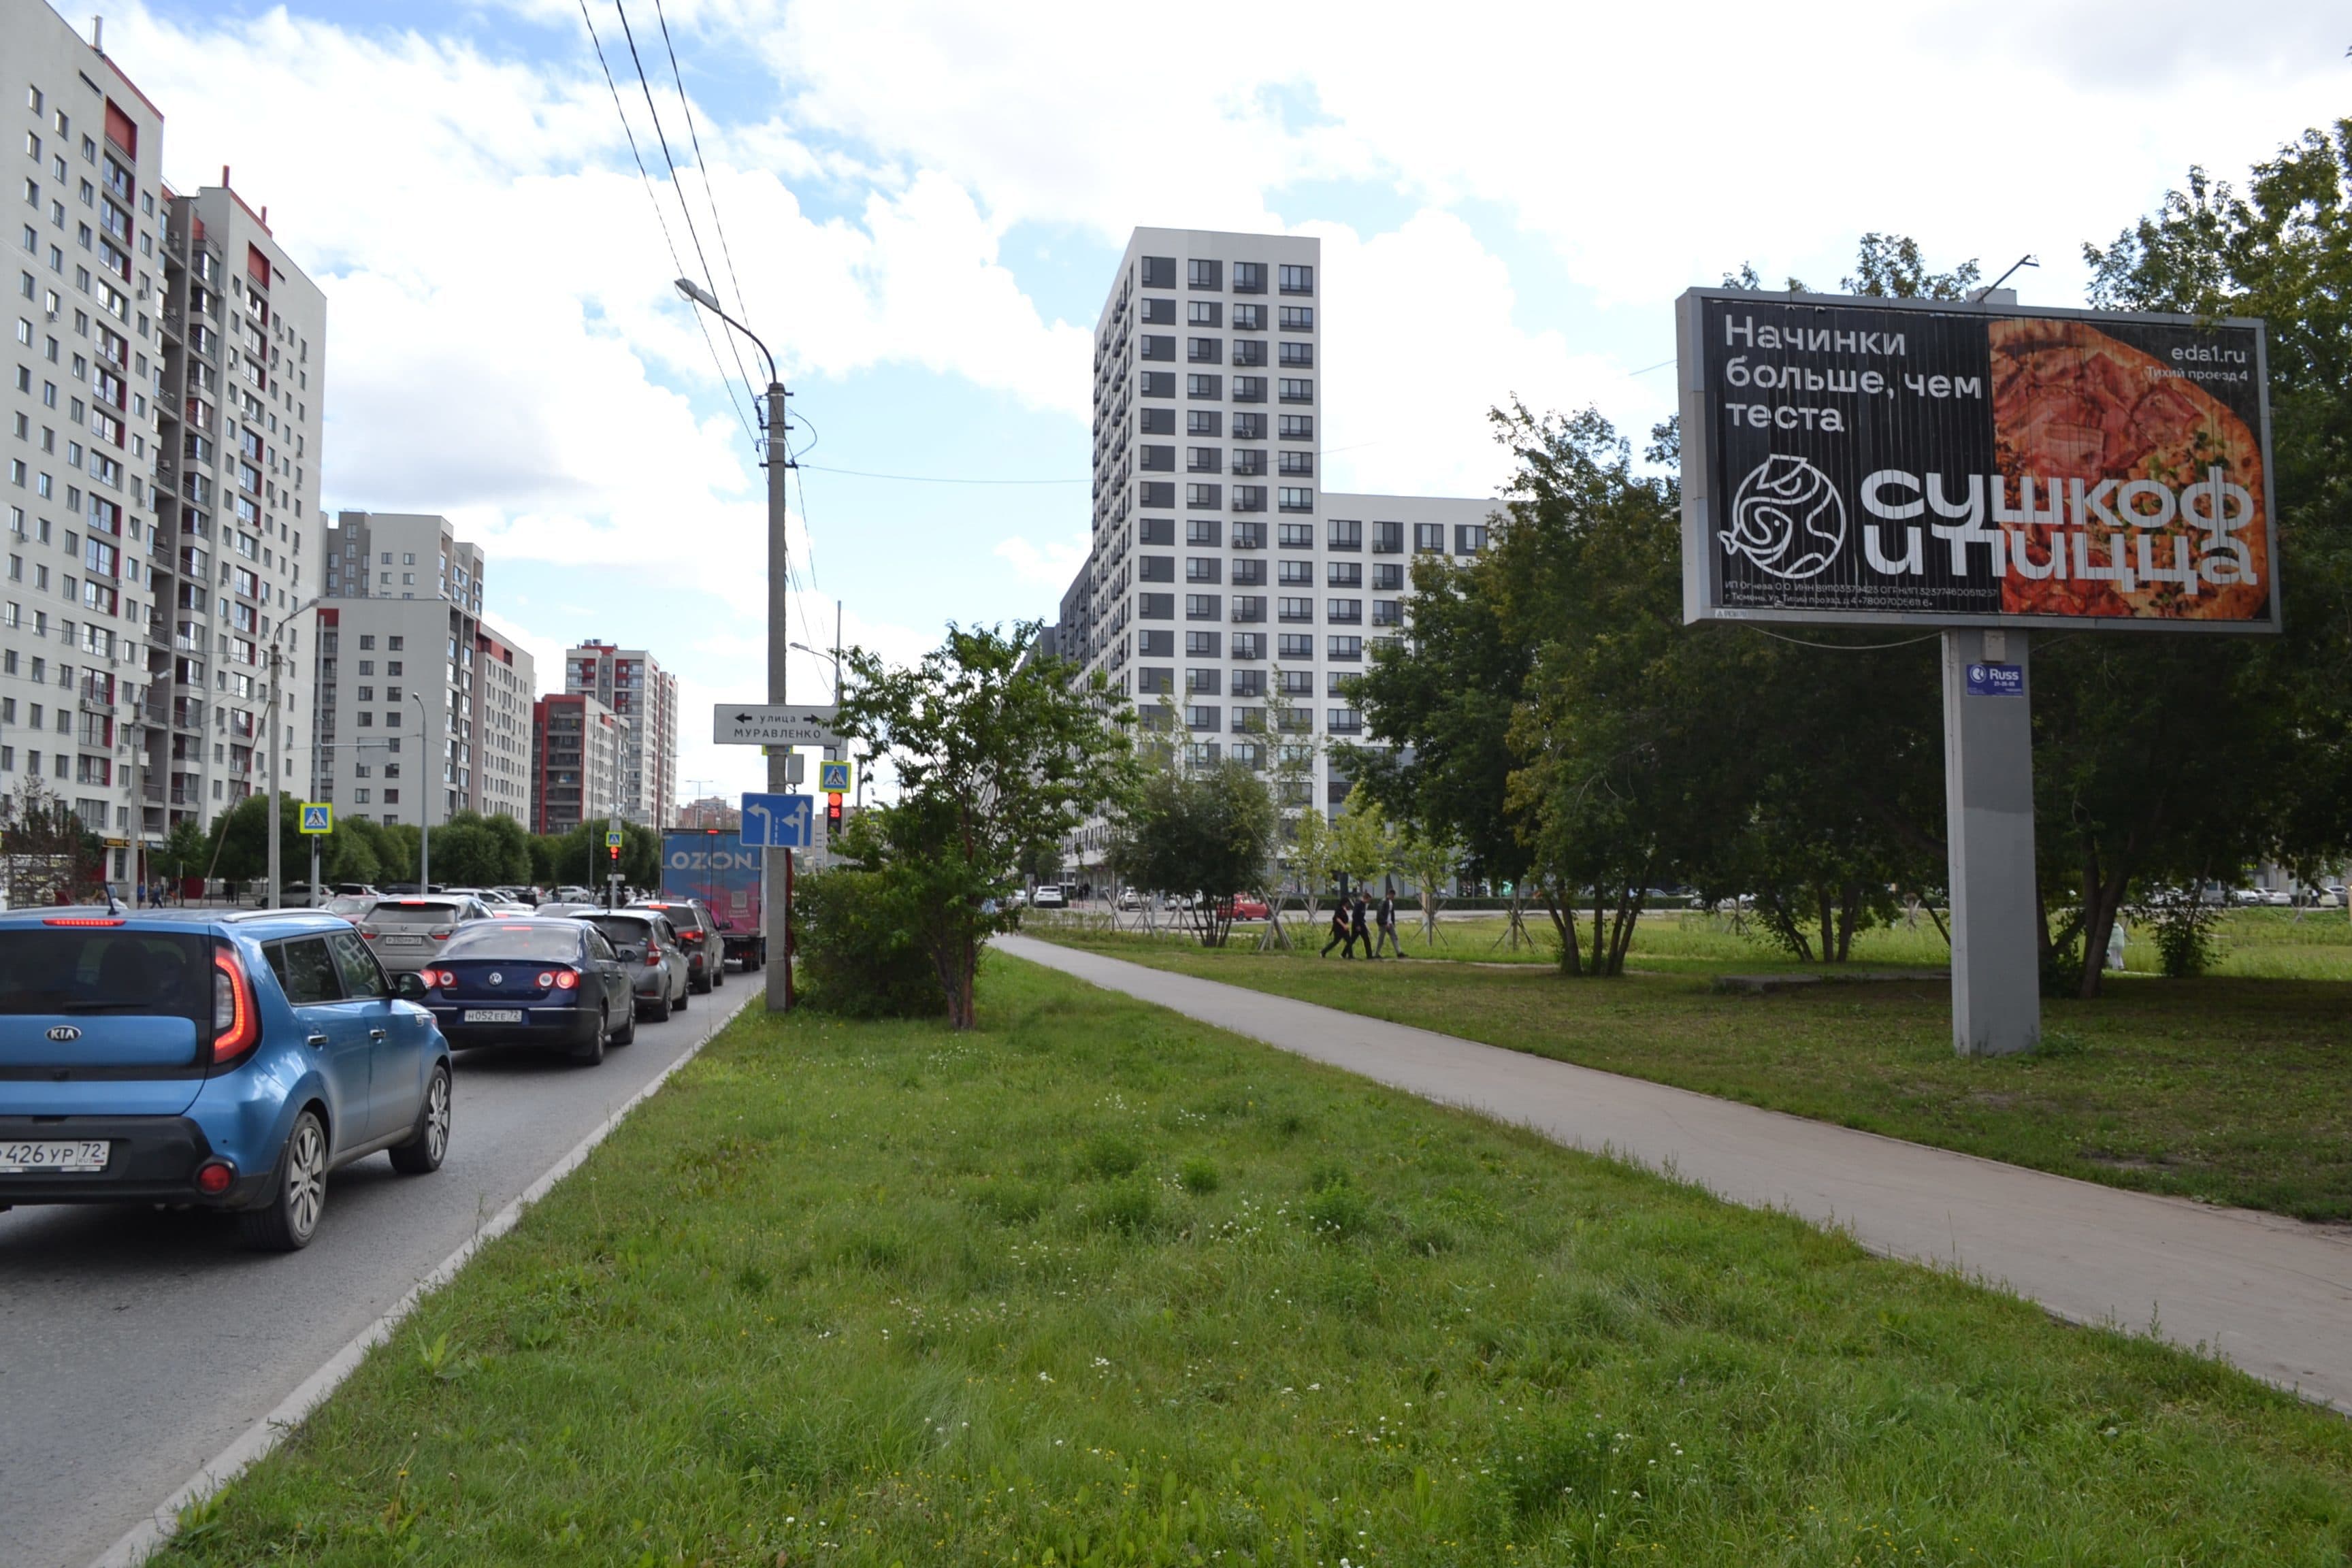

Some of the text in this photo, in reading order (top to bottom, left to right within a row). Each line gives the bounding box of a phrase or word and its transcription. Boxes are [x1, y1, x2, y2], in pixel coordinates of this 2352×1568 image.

[1725, 314, 1906, 356] Начинки
[2171, 344, 2246, 363] eda1.ru
[1725, 355, 1982, 400] больше, чем
[2146, 365, 2248, 382] Тихий проезд 4
[1725, 402, 1845, 432] теста
[1860, 466, 2254, 536] сушкоф
[1725, 581, 1738, 589] ИП
[1794, 583, 1814, 592] ИНН
[1989, 669, 2019, 681] Russ
[760, 715, 796, 724] улица
[734, 728, 821, 739] МУРАВЛЕНКО
[671, 851, 752, 870] OZON
[50, 1028, 76, 1040] KIA
[81, 1143, 101, 1158] 72
